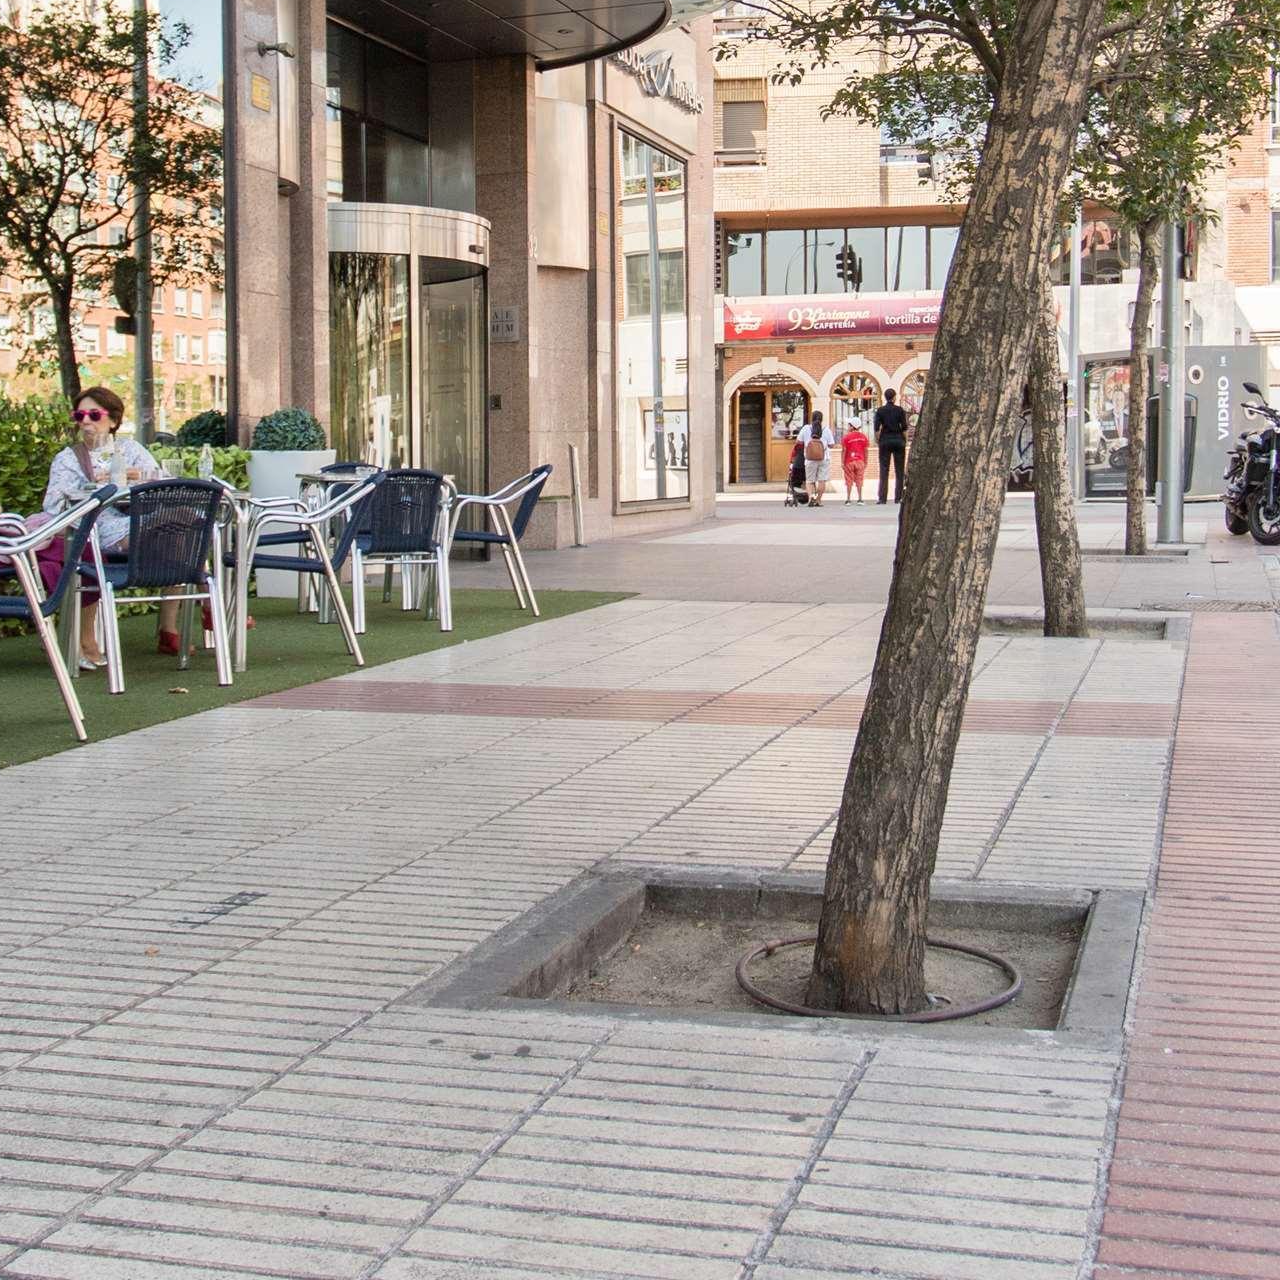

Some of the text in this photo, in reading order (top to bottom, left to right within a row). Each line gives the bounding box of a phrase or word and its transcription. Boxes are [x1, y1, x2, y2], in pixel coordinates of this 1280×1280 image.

[787, 308, 816, 331] 93
[885, 312, 937, 325] tortilla de
[1217, 375, 1230, 441] VIDRIO
